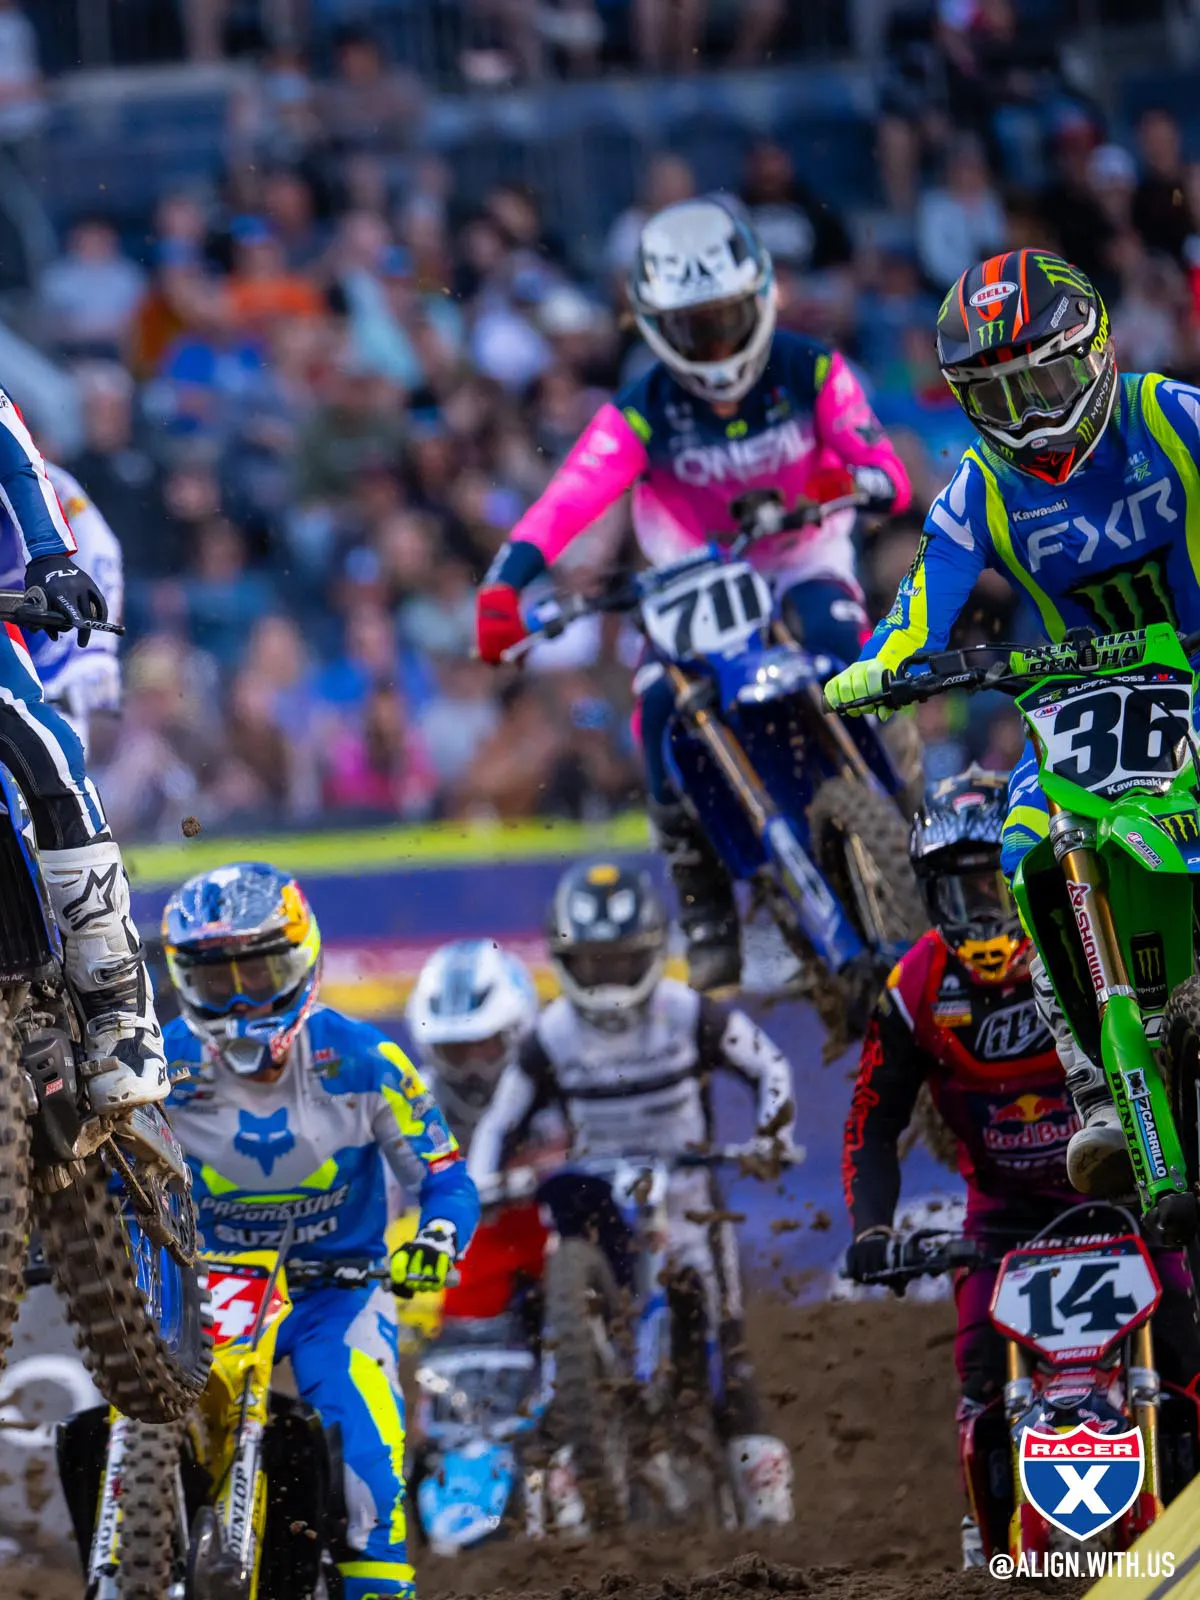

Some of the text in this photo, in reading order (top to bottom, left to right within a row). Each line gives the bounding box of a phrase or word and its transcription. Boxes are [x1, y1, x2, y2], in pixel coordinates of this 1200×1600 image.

[976, 286, 1011, 303] BELL
[1012, 499, 1069, 523] Kawasaki
[1026, 476, 1178, 574] FXR
[45, 568, 79, 584] FLY
[656, 572, 763, 656] 711
[1052, 688, 1190, 787] 36
[1107, 776, 1164, 795] Kawasaki
[1075, 910, 1106, 993] SHOWA
[1141, 1108, 1168, 1178] CARRILLO
[200, 1186, 351, 1225] PROGRESSIVE
[214, 1215, 339, 1248] SUZUKI
[1018, 1261, 1139, 1340] 14
[1056, 1350, 1099, 1362] DUCATI
